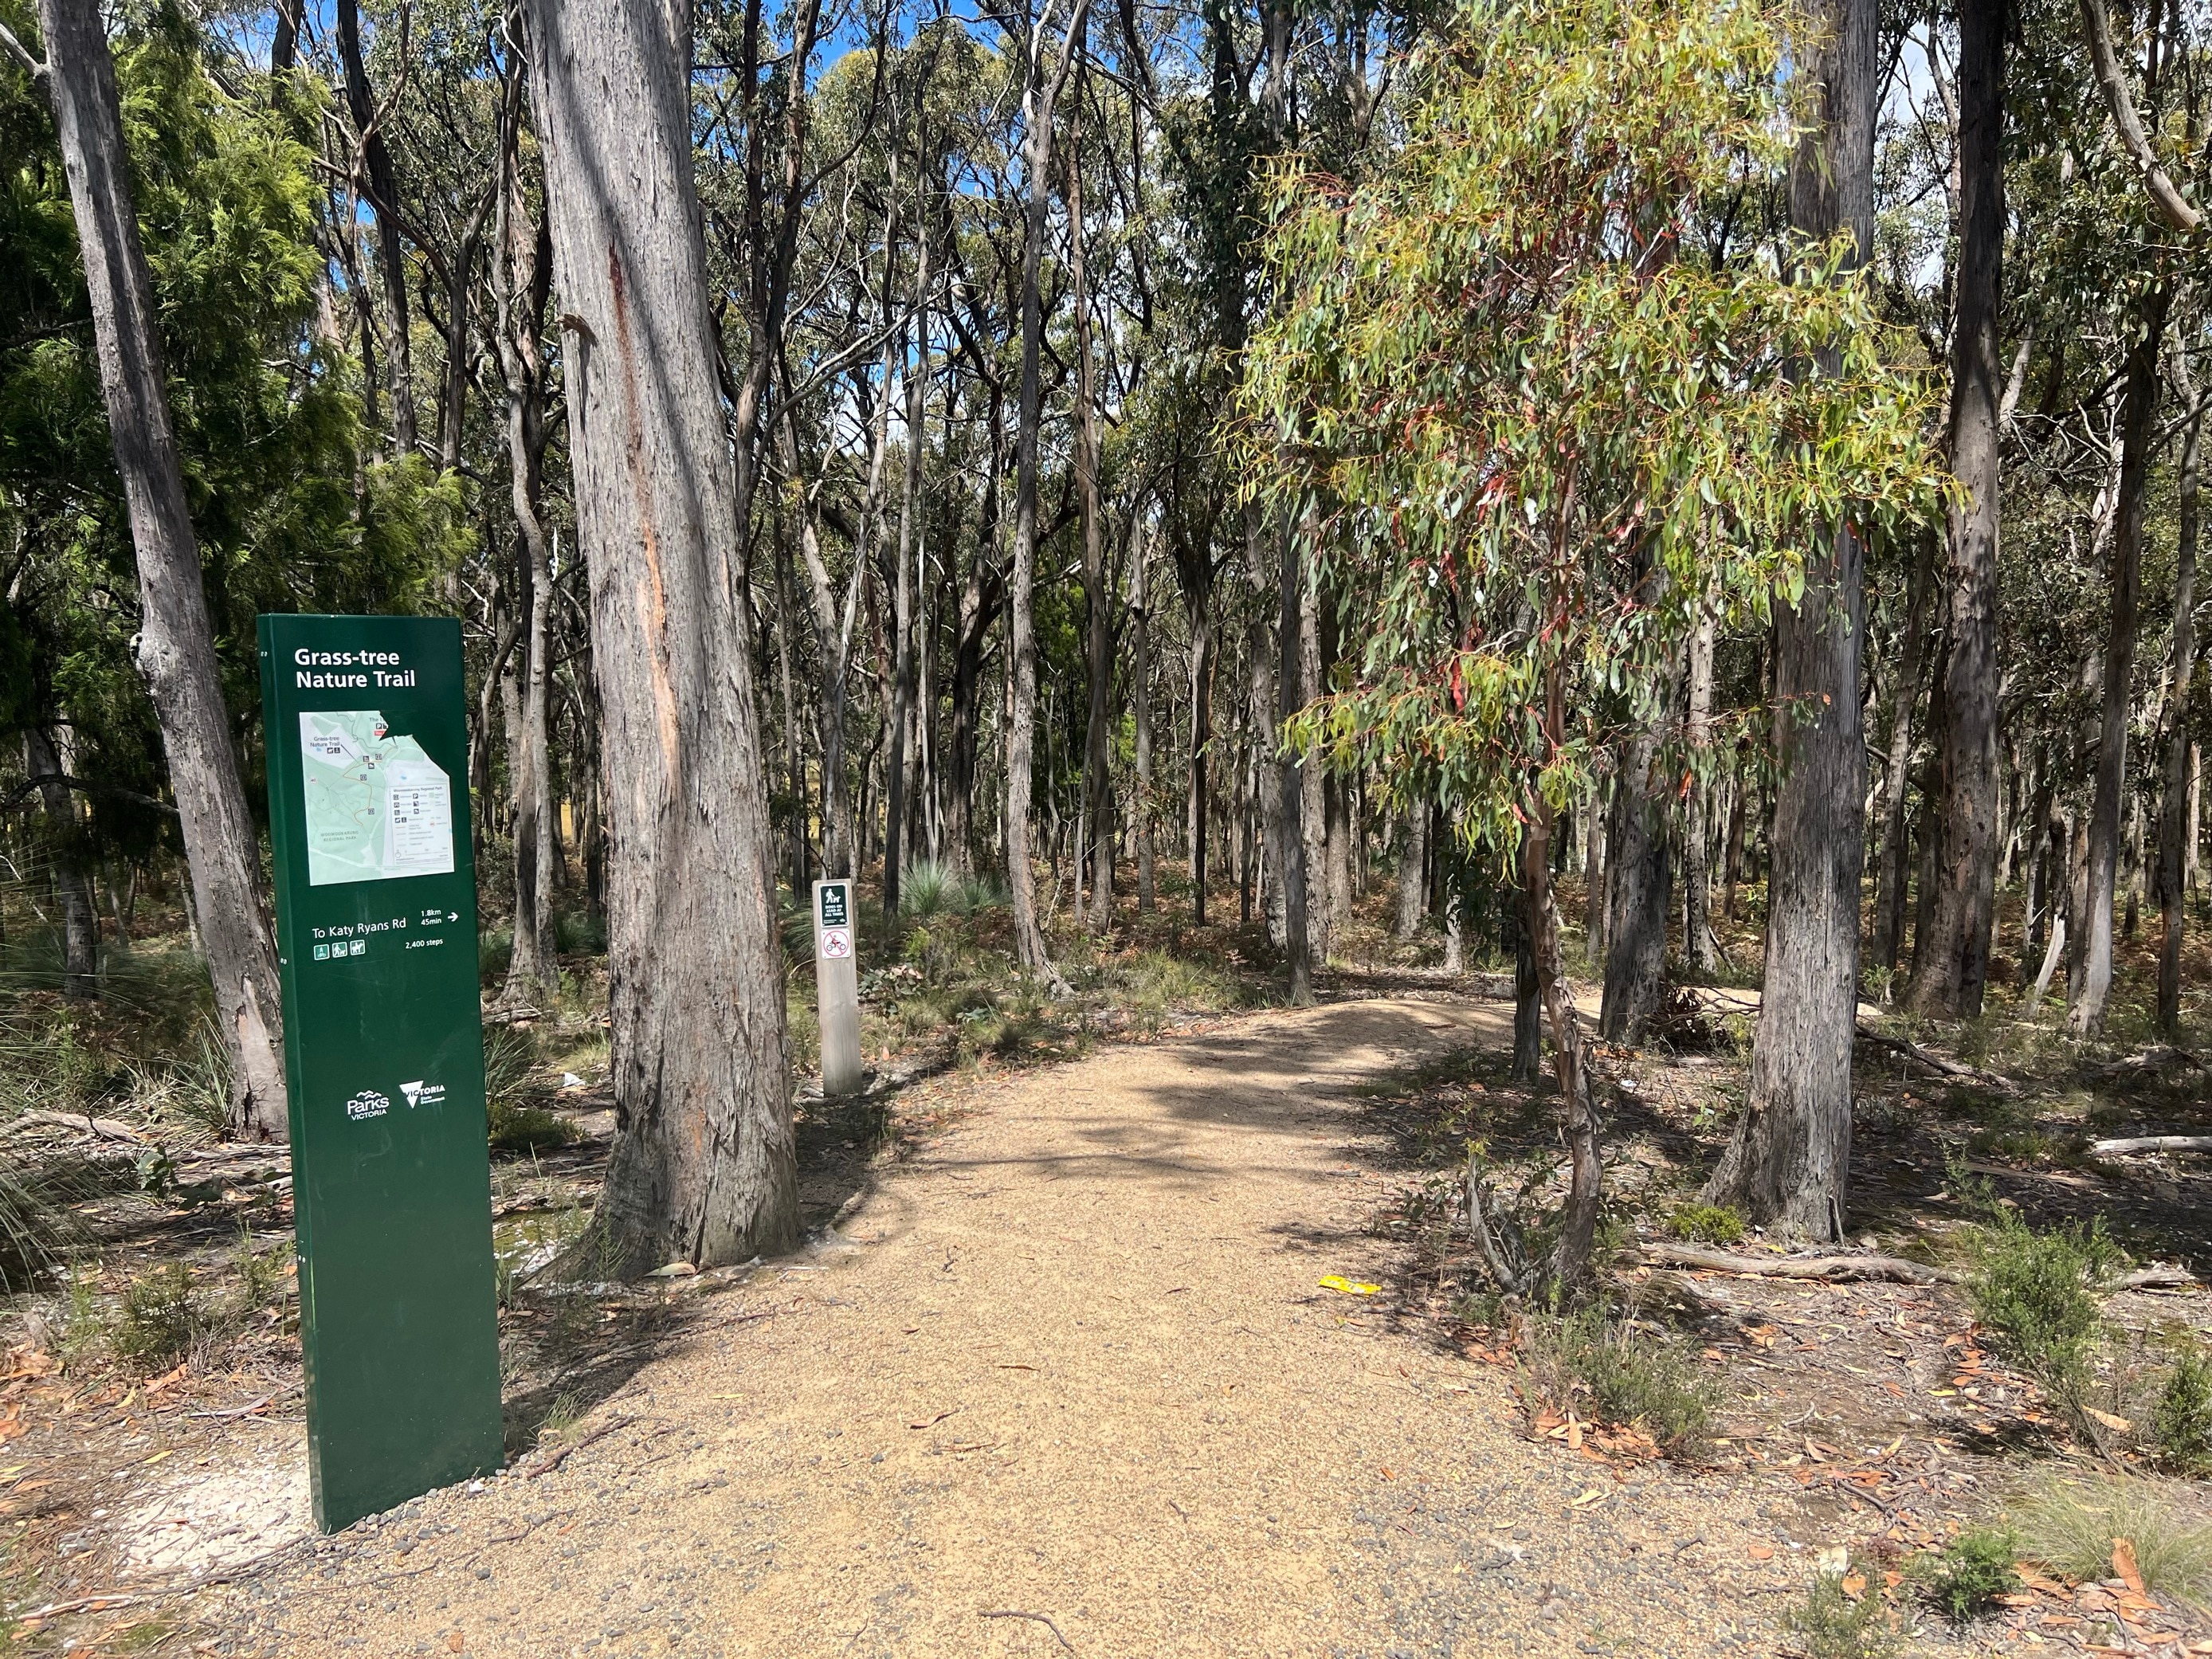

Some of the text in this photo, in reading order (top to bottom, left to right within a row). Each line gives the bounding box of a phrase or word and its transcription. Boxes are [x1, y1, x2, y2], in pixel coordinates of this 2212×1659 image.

[295, 648, 400, 665] Grass-tree
[296, 669, 416, 688] Nature Trail
[312, 917, 406, 939] To Katy Ryans Rd
[405, 938, 444, 949] 2,400 steps
[406, 1084, 445, 1096] VICTORIA
[347, 1097, 390, 1115] Parks
[351, 1108, 387, 1121] VICTORIA
